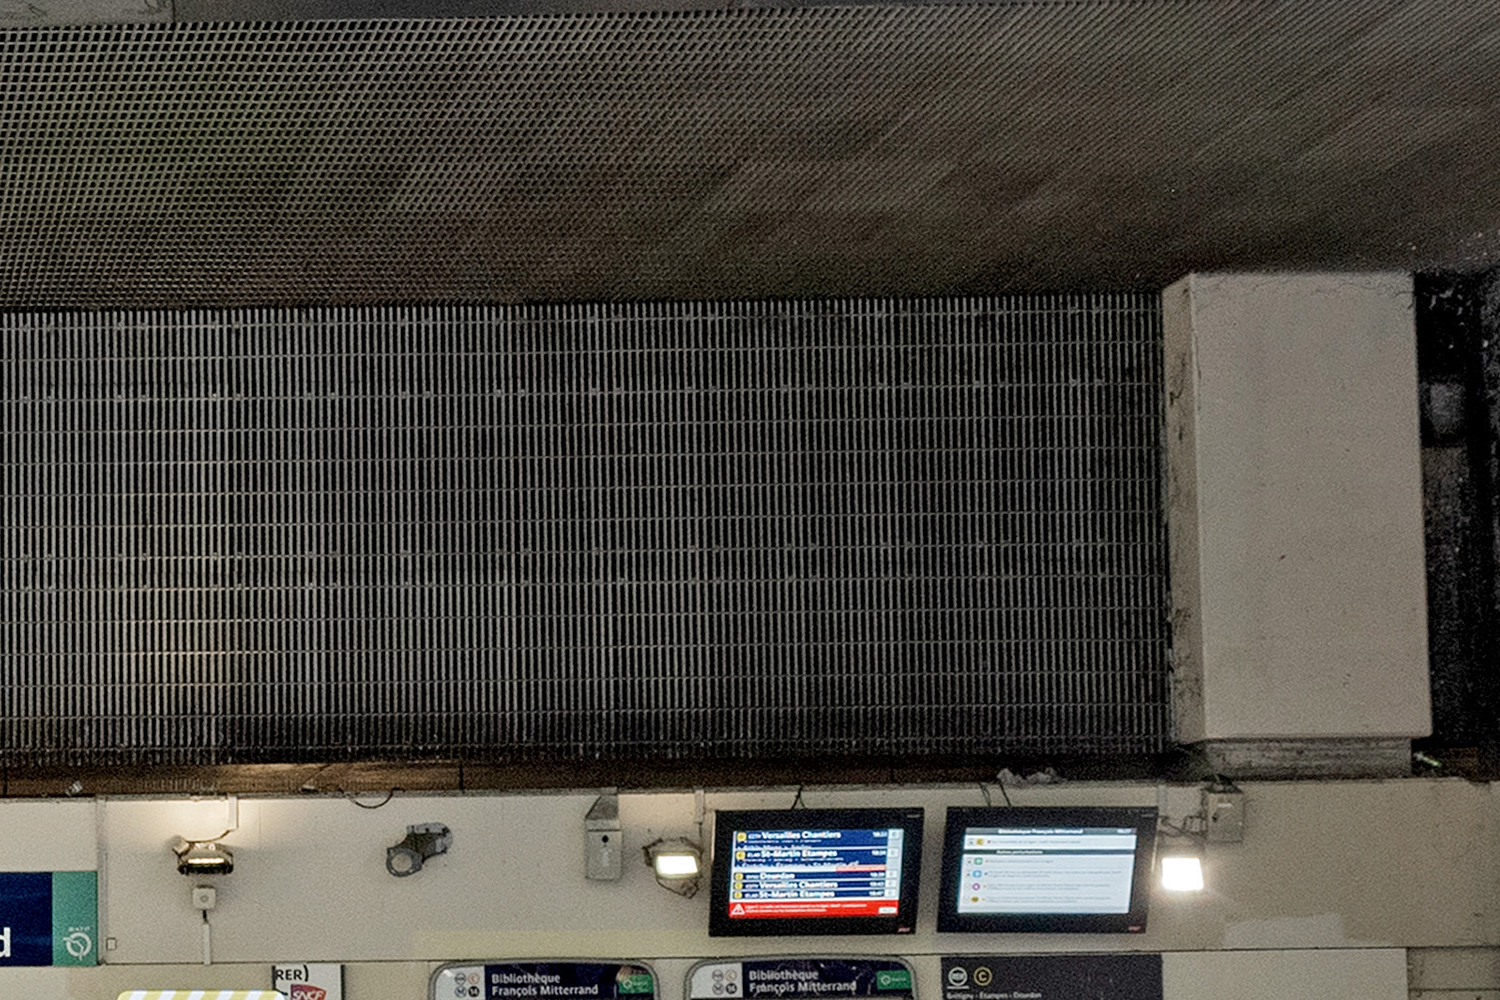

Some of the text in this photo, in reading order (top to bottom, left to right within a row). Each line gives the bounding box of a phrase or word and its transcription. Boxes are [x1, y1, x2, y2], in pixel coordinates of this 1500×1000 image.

[492, 974, 560, 985] Bibliothèque
[749, 970, 819, 981] Bibliothèque
[492, 984, 598, 997] François Mitterrand
[750, 981, 857, 996] François Mitterrand
[292, 991, 324, 1000] SNCF
